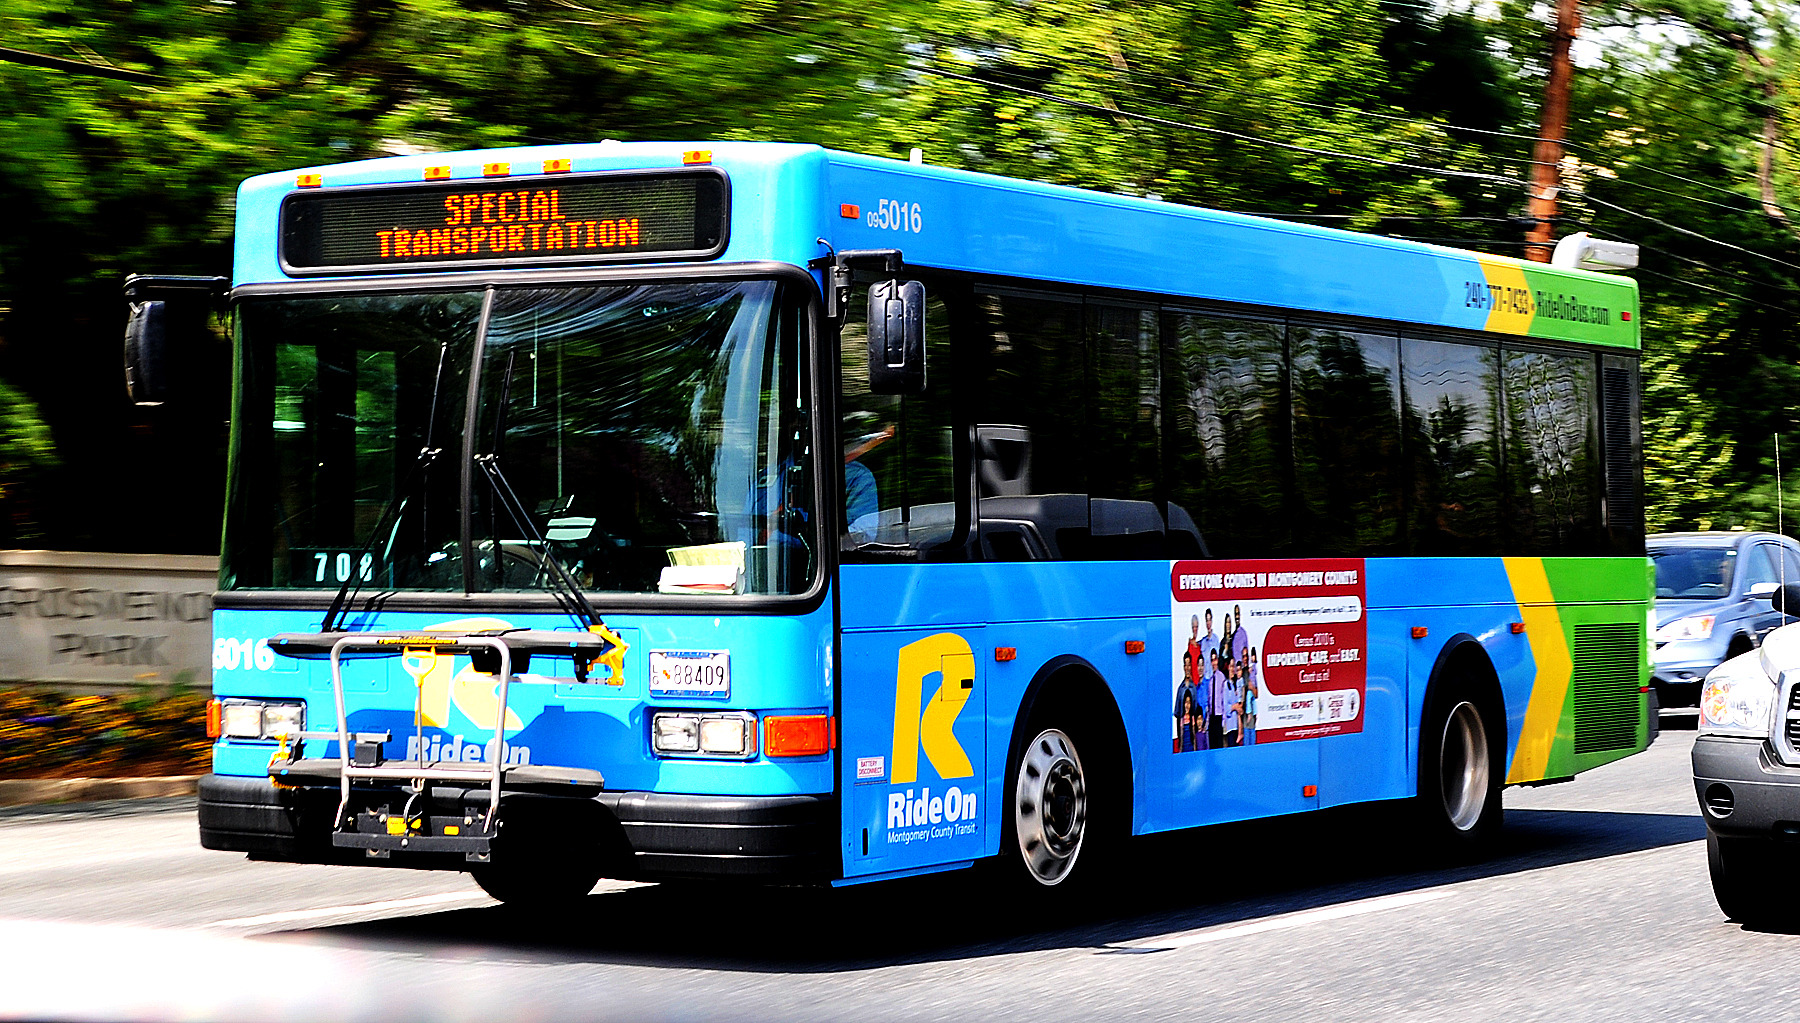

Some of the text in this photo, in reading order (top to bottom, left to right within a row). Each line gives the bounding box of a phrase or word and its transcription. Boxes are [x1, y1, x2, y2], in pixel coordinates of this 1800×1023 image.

[444, 190, 566, 225] SPECIAL
[376, 218, 639, 257] TRANSPORTATION
[1536, 290, 1611, 326] RideOnBus.com
[314, 552, 373, 582] 708
[1179, 574, 1223, 590] EVERYONE
[1223, 573, 1256, 589] COUNTS
[1257, 573, 1267, 588] IN
[1268, 571, 1325, 587] MONTGOMERY
[212, 637, 275, 671] 5016
[674, 664, 724, 686] 88409
[858, 766, 883, 775] DISCONNECT
[887, 821, 976, 845] Montgomery County Transit
